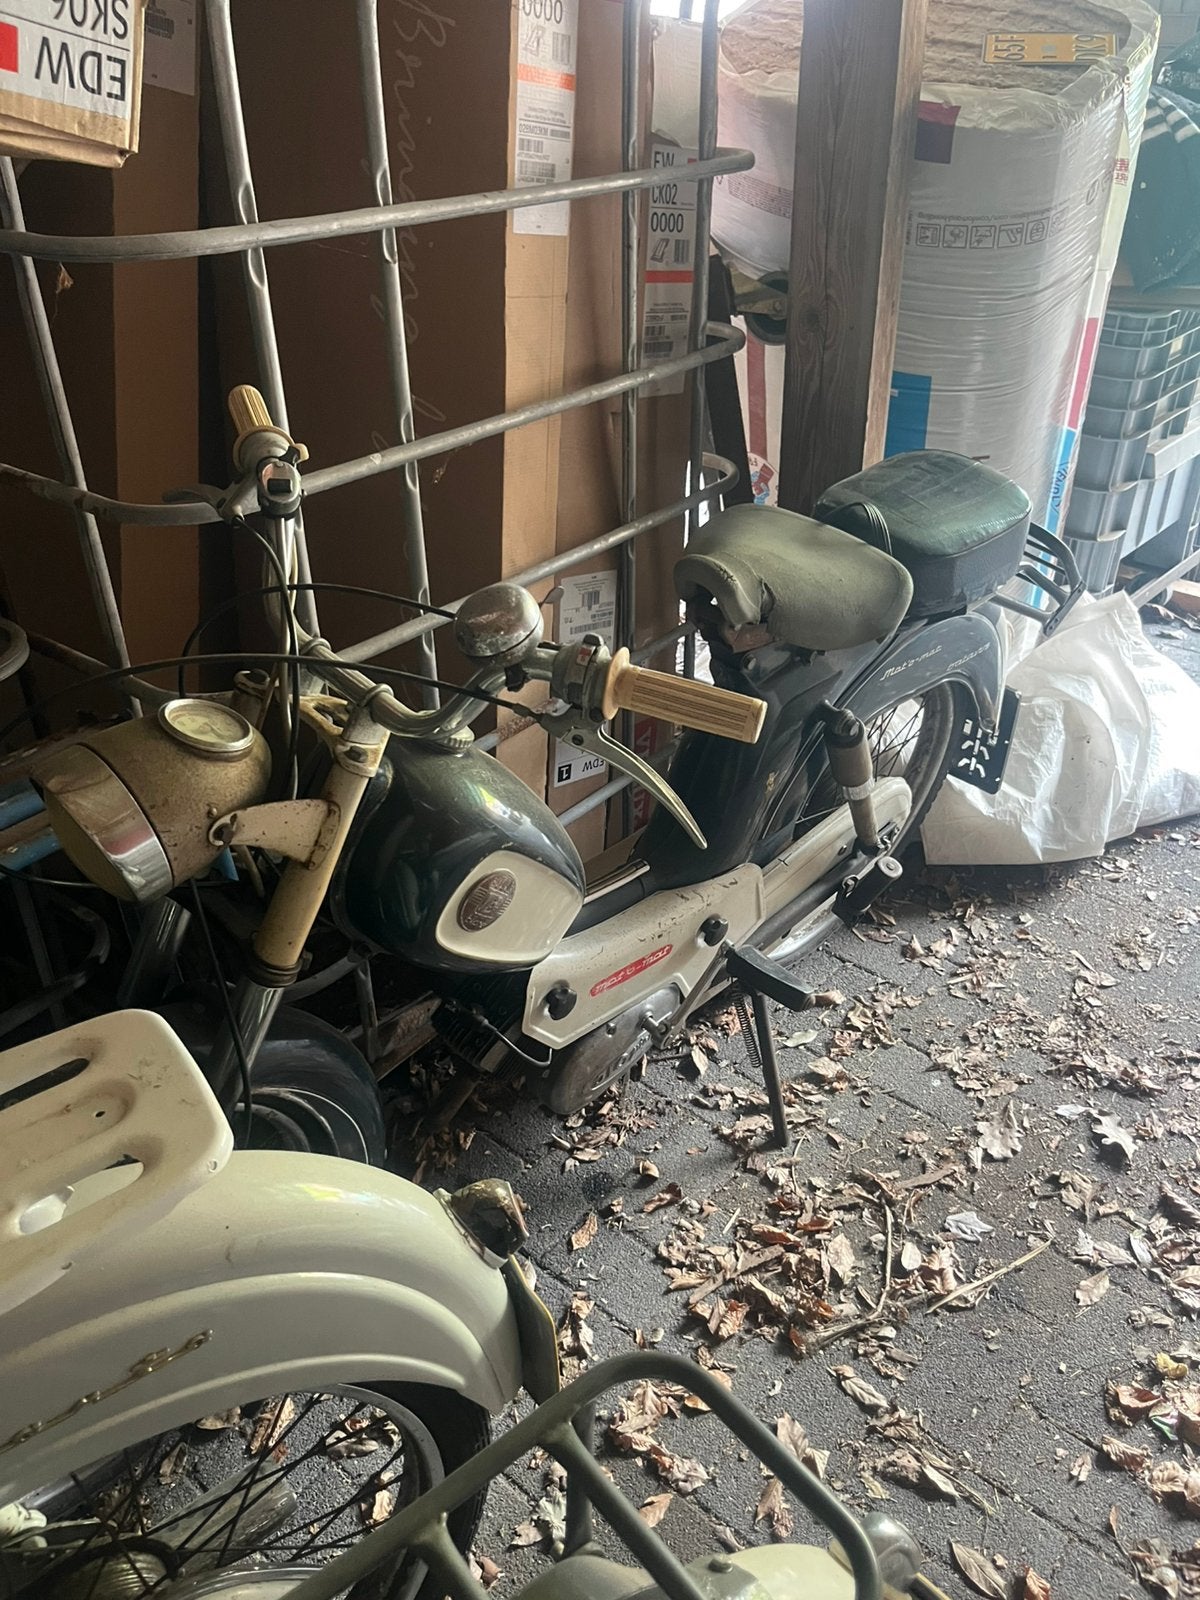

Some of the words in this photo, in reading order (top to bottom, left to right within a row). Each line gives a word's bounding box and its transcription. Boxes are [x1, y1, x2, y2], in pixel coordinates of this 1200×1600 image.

[35, 36, 126, 101] EDW
[652, 183, 678, 205] CK02
[650, 211, 684, 233] 0000
